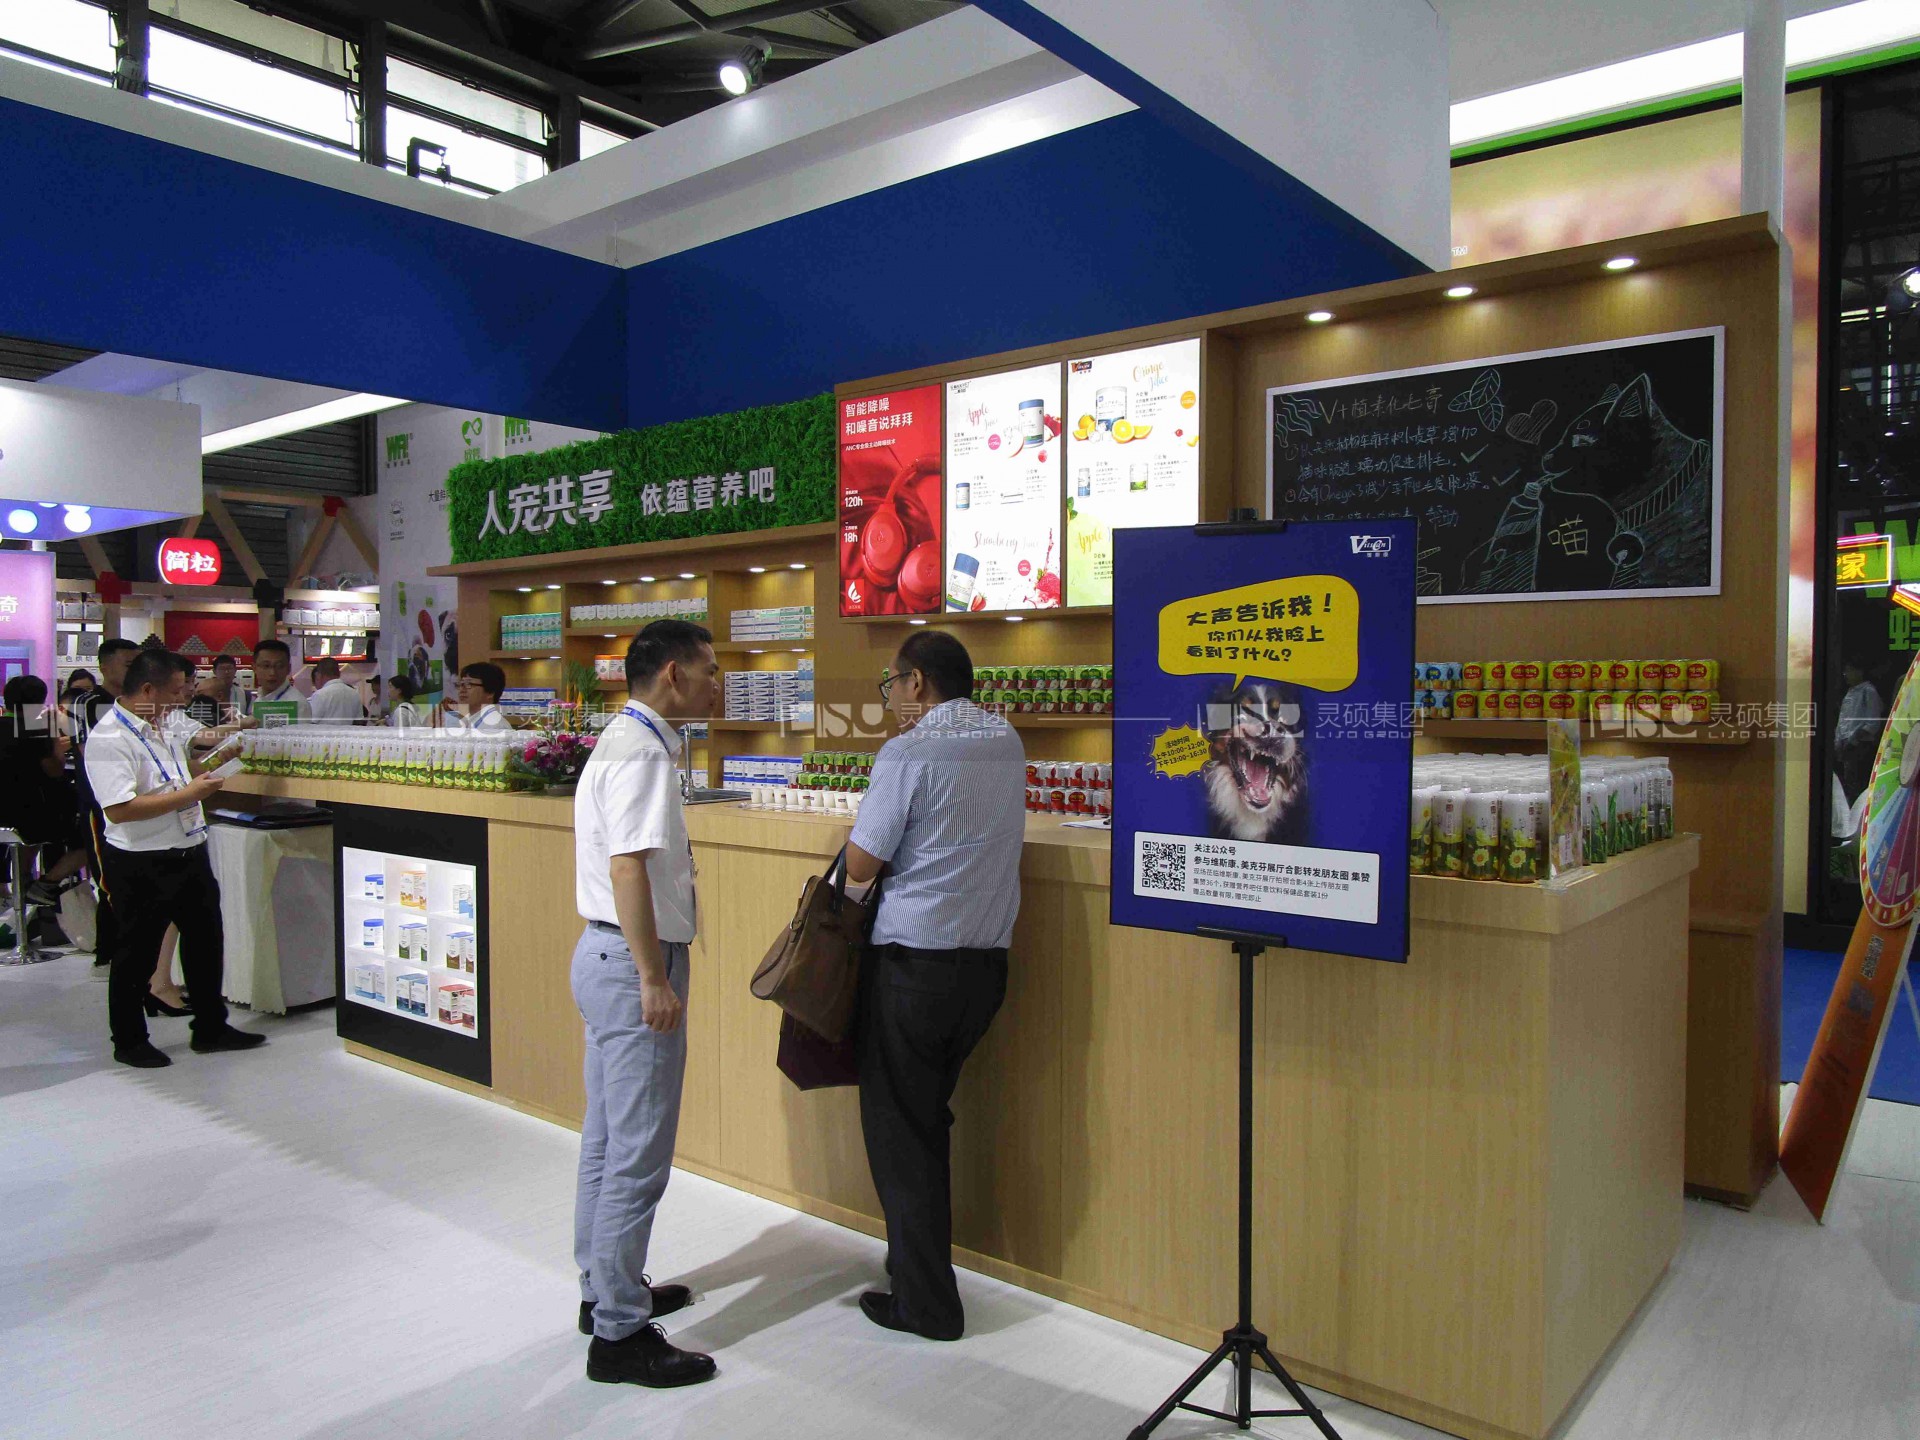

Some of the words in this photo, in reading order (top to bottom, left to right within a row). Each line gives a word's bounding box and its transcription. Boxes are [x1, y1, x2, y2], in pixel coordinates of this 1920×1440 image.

[845, 397, 890, 418] 智能降噪
[845, 412, 913, 436] 和噪音说拜拜
[478, 469, 613, 541] 人宠共享
[641, 466, 775, 516] 依蕴营养吧
[844, 497, 863, 508] 120h
[844, 532, 858, 543] 18h
[1547, 514, 1589, 556] 喵
[1837, 552, 1866, 580] 家
[1207, 625, 1325, 643] 你们从我脸上
[1156, 740, 1205, 760] 上午10:00-12:00
[1157, 748, 1207, 768] 下午13:00-16:30
[1194, 844, 1237, 856] 关注公众号
